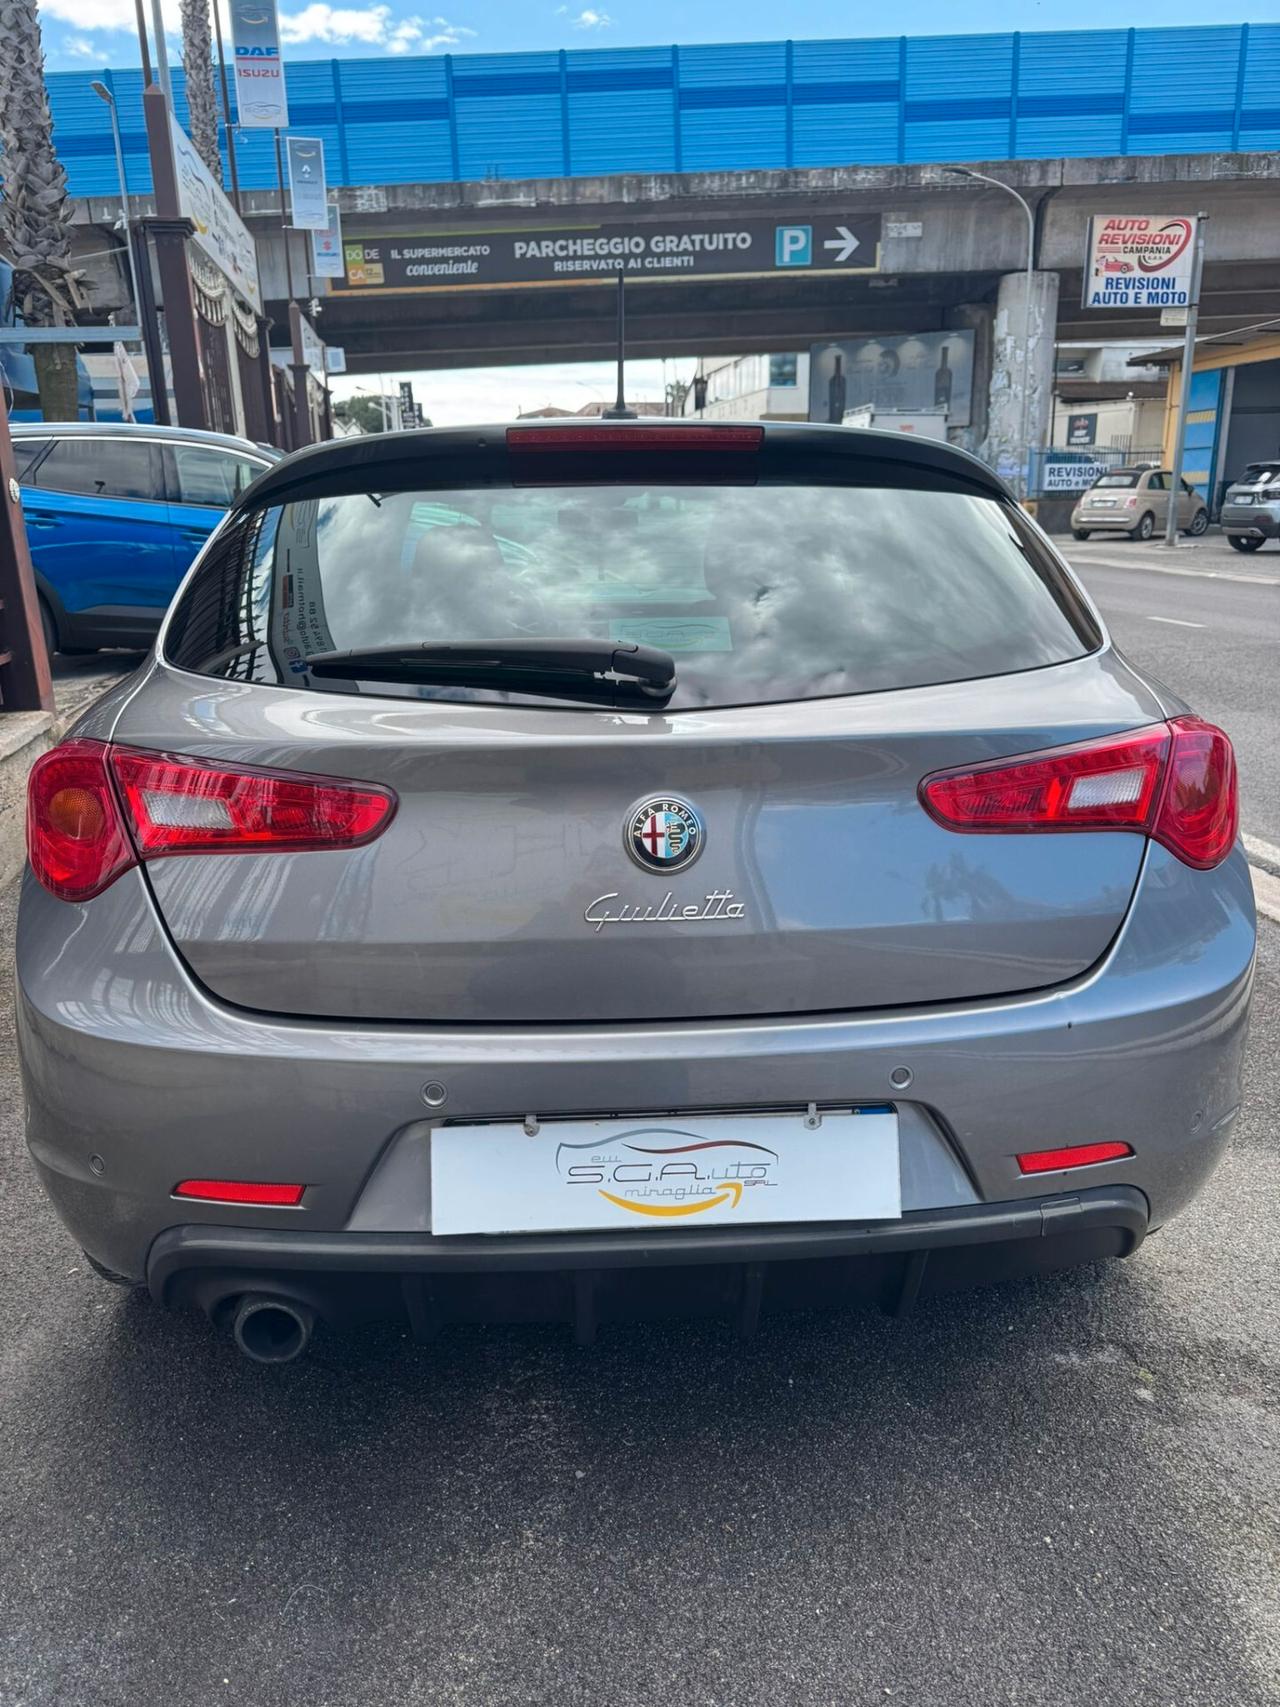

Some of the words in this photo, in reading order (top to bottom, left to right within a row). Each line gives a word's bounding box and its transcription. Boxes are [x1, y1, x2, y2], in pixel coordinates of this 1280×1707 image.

[235, 46, 279, 56] DAF
[238, 69, 280, 78] ISUZU
[1104, 219, 1151, 231] AUTO
[514, 236, 646, 259] PARCHEGGIO
[650, 232, 752, 253] GRATUITO
[1098, 233, 1182, 245] REVISIONI
[390, 249, 402, 259] IL
[403, 245, 491, 259] SUPERMERCATO
[782, 229, 807, 263] P
[1122, 246, 1171, 254] CAMPANIA
[406, 260, 480, 276] conveniente
[553, 259, 625, 272] RISERVATO
[627, 257, 642, 269] AI
[644, 256, 694, 268] CLIENTI
[1105, 277, 1176, 290] REVISIONI
[1091, 291, 1129, 305] AUTO
[1133, 291, 1142, 304] E
[1146, 290, 1187, 303] MOTO
[1048, 466, 1108, 478] REVISIONI
[1047, 479, 1073, 488] AUTO
[633, 807, 656, 838] ALFA
[661, 803, 697, 836] ROMEO
[584, 889, 745, 932] Giulietta
